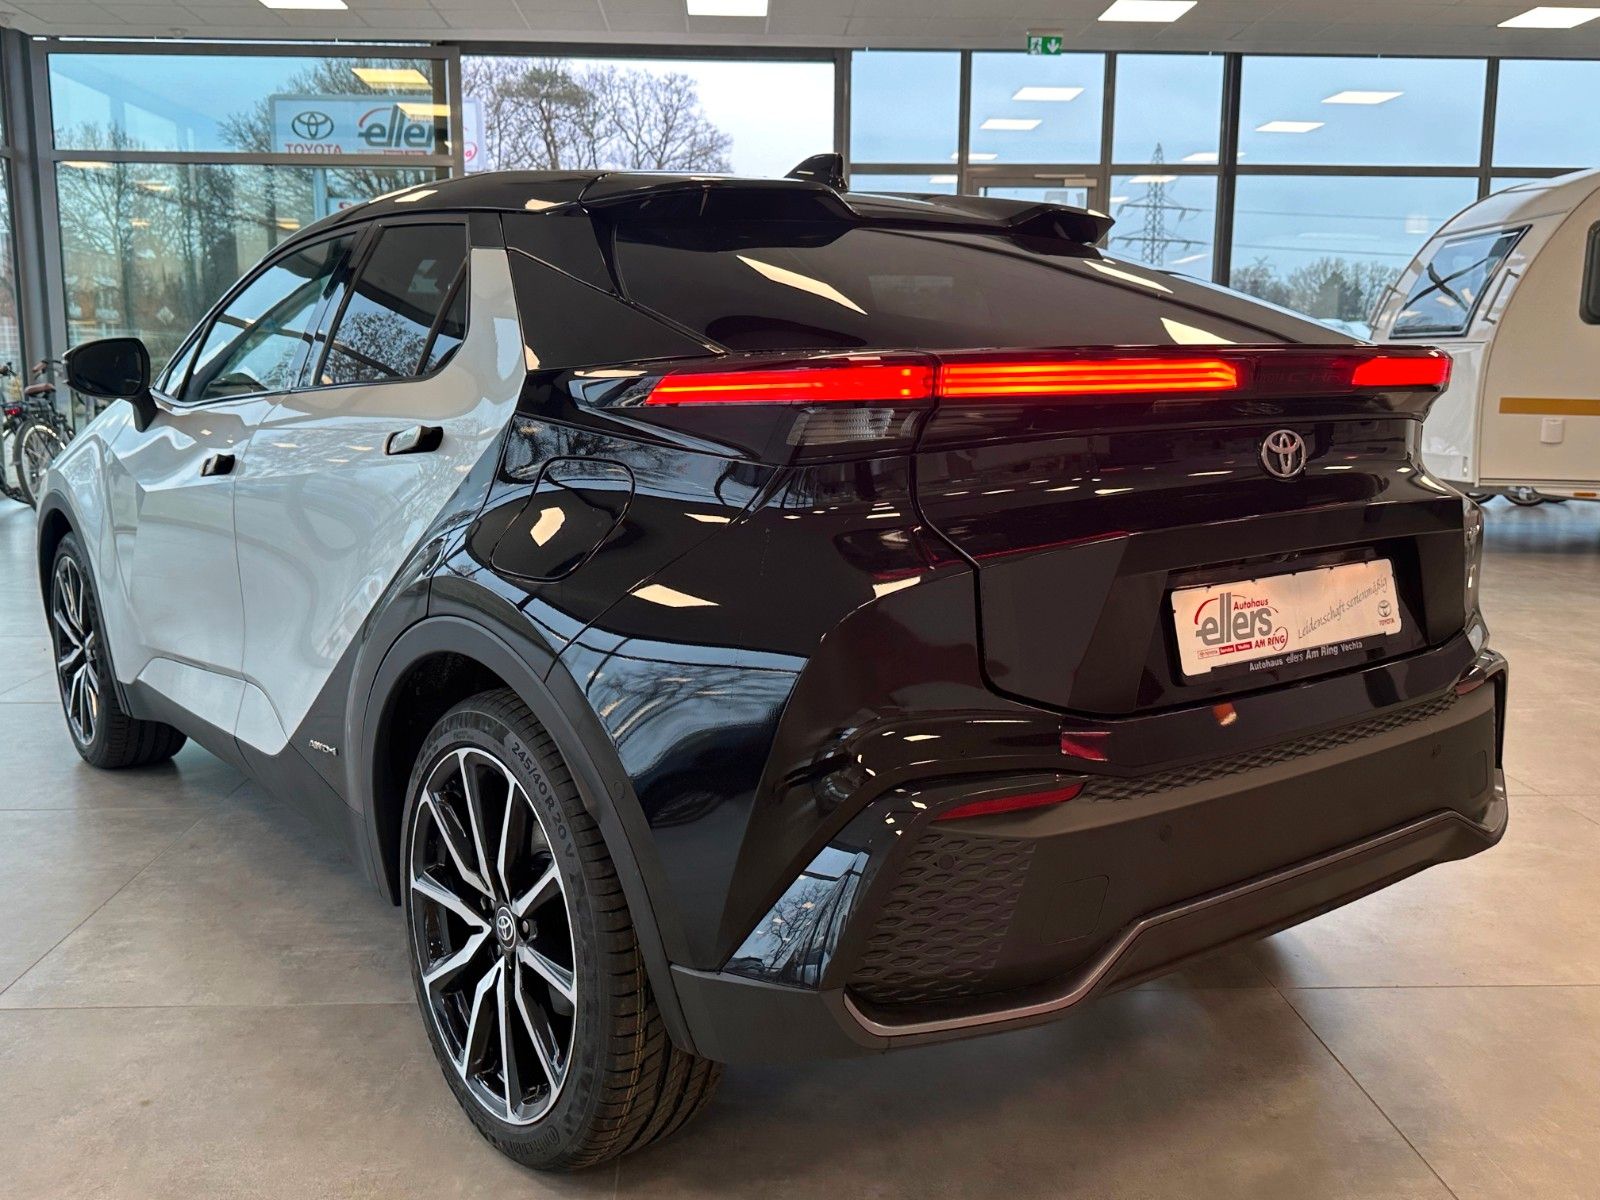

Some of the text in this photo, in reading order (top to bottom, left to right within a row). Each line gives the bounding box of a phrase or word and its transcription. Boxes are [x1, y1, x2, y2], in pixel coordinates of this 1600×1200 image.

[358, 105, 433, 148] eller
[285, 143, 342, 154] TOYOTA
[1196, 592, 1273, 646] ellers
[1233, 598, 1269, 611] Autohaus
[1249, 640, 1363, 672] Autohaus ellers Am Ring Vechta
[1254, 639, 1266, 649] AM
[1267, 634, 1286, 648] RING
[511, 741, 548, 796] 245/40
[544, 795, 555, 811] R
[552, 811, 567, 840] 20
